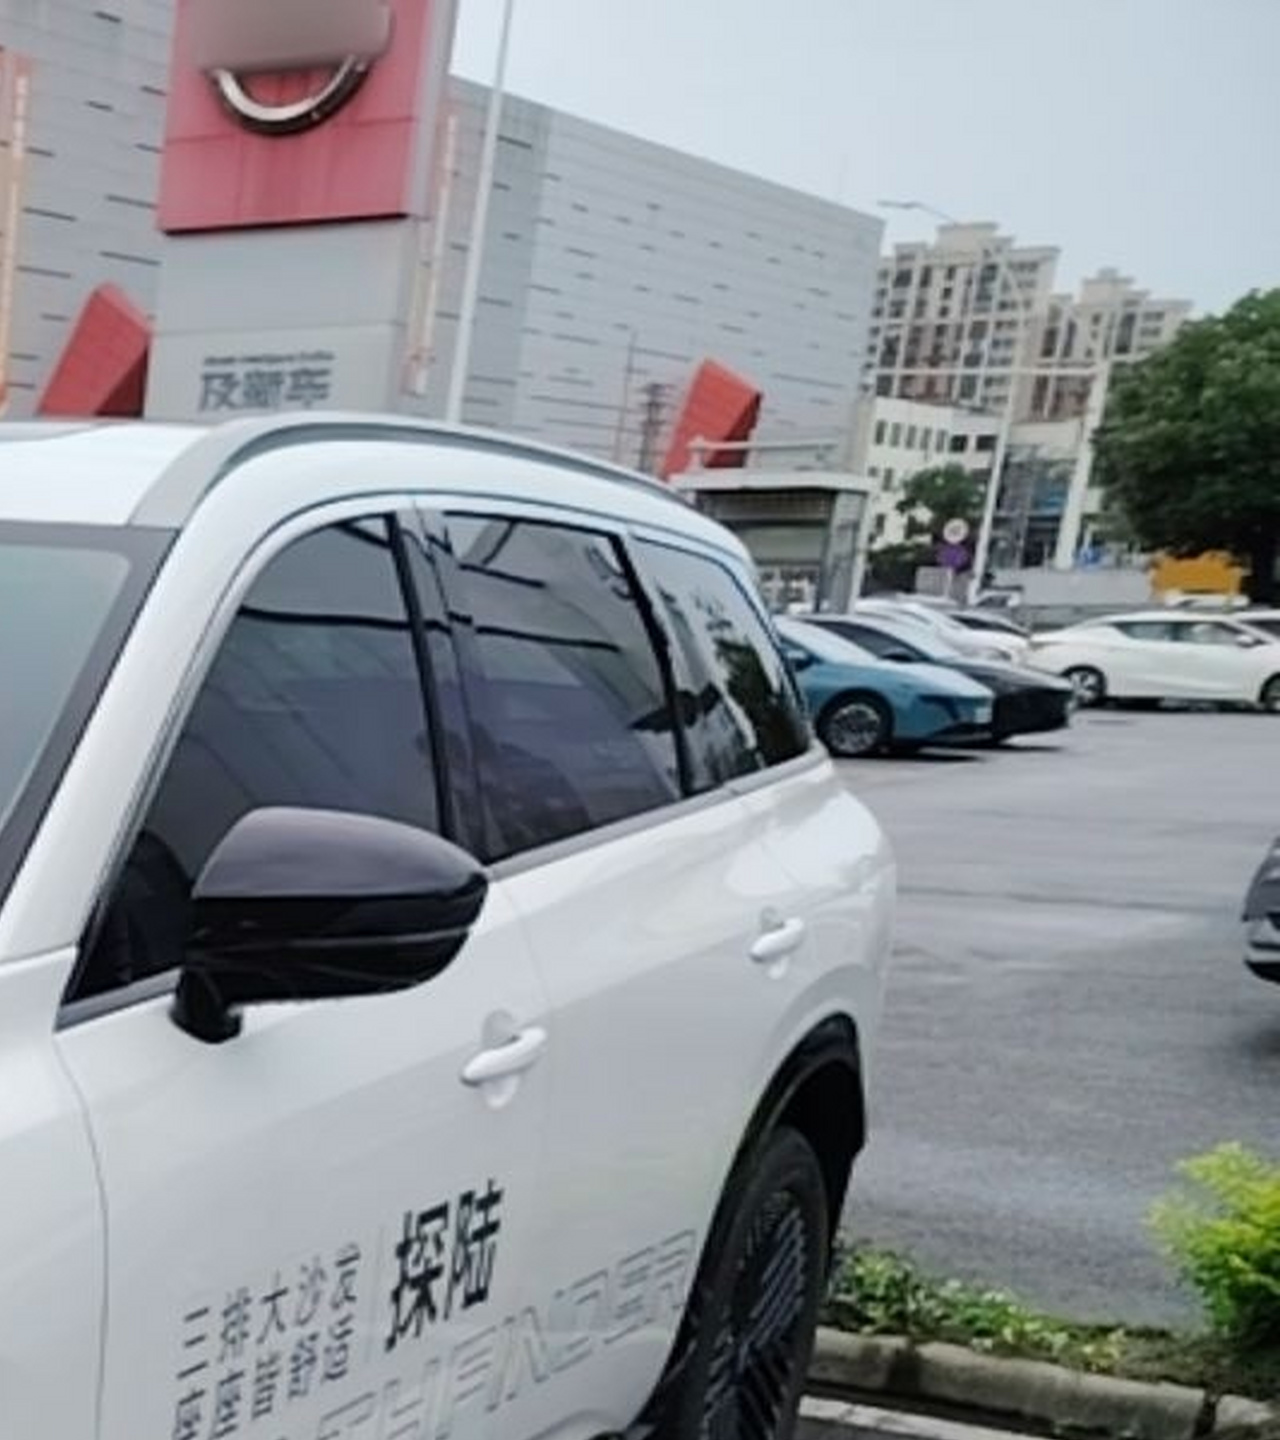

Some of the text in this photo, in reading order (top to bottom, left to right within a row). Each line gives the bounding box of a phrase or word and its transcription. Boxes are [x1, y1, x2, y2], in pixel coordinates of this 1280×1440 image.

[176, 1242, 360, 1381] 三排大沙发
[385, 1178, 504, 1354] 探陆
